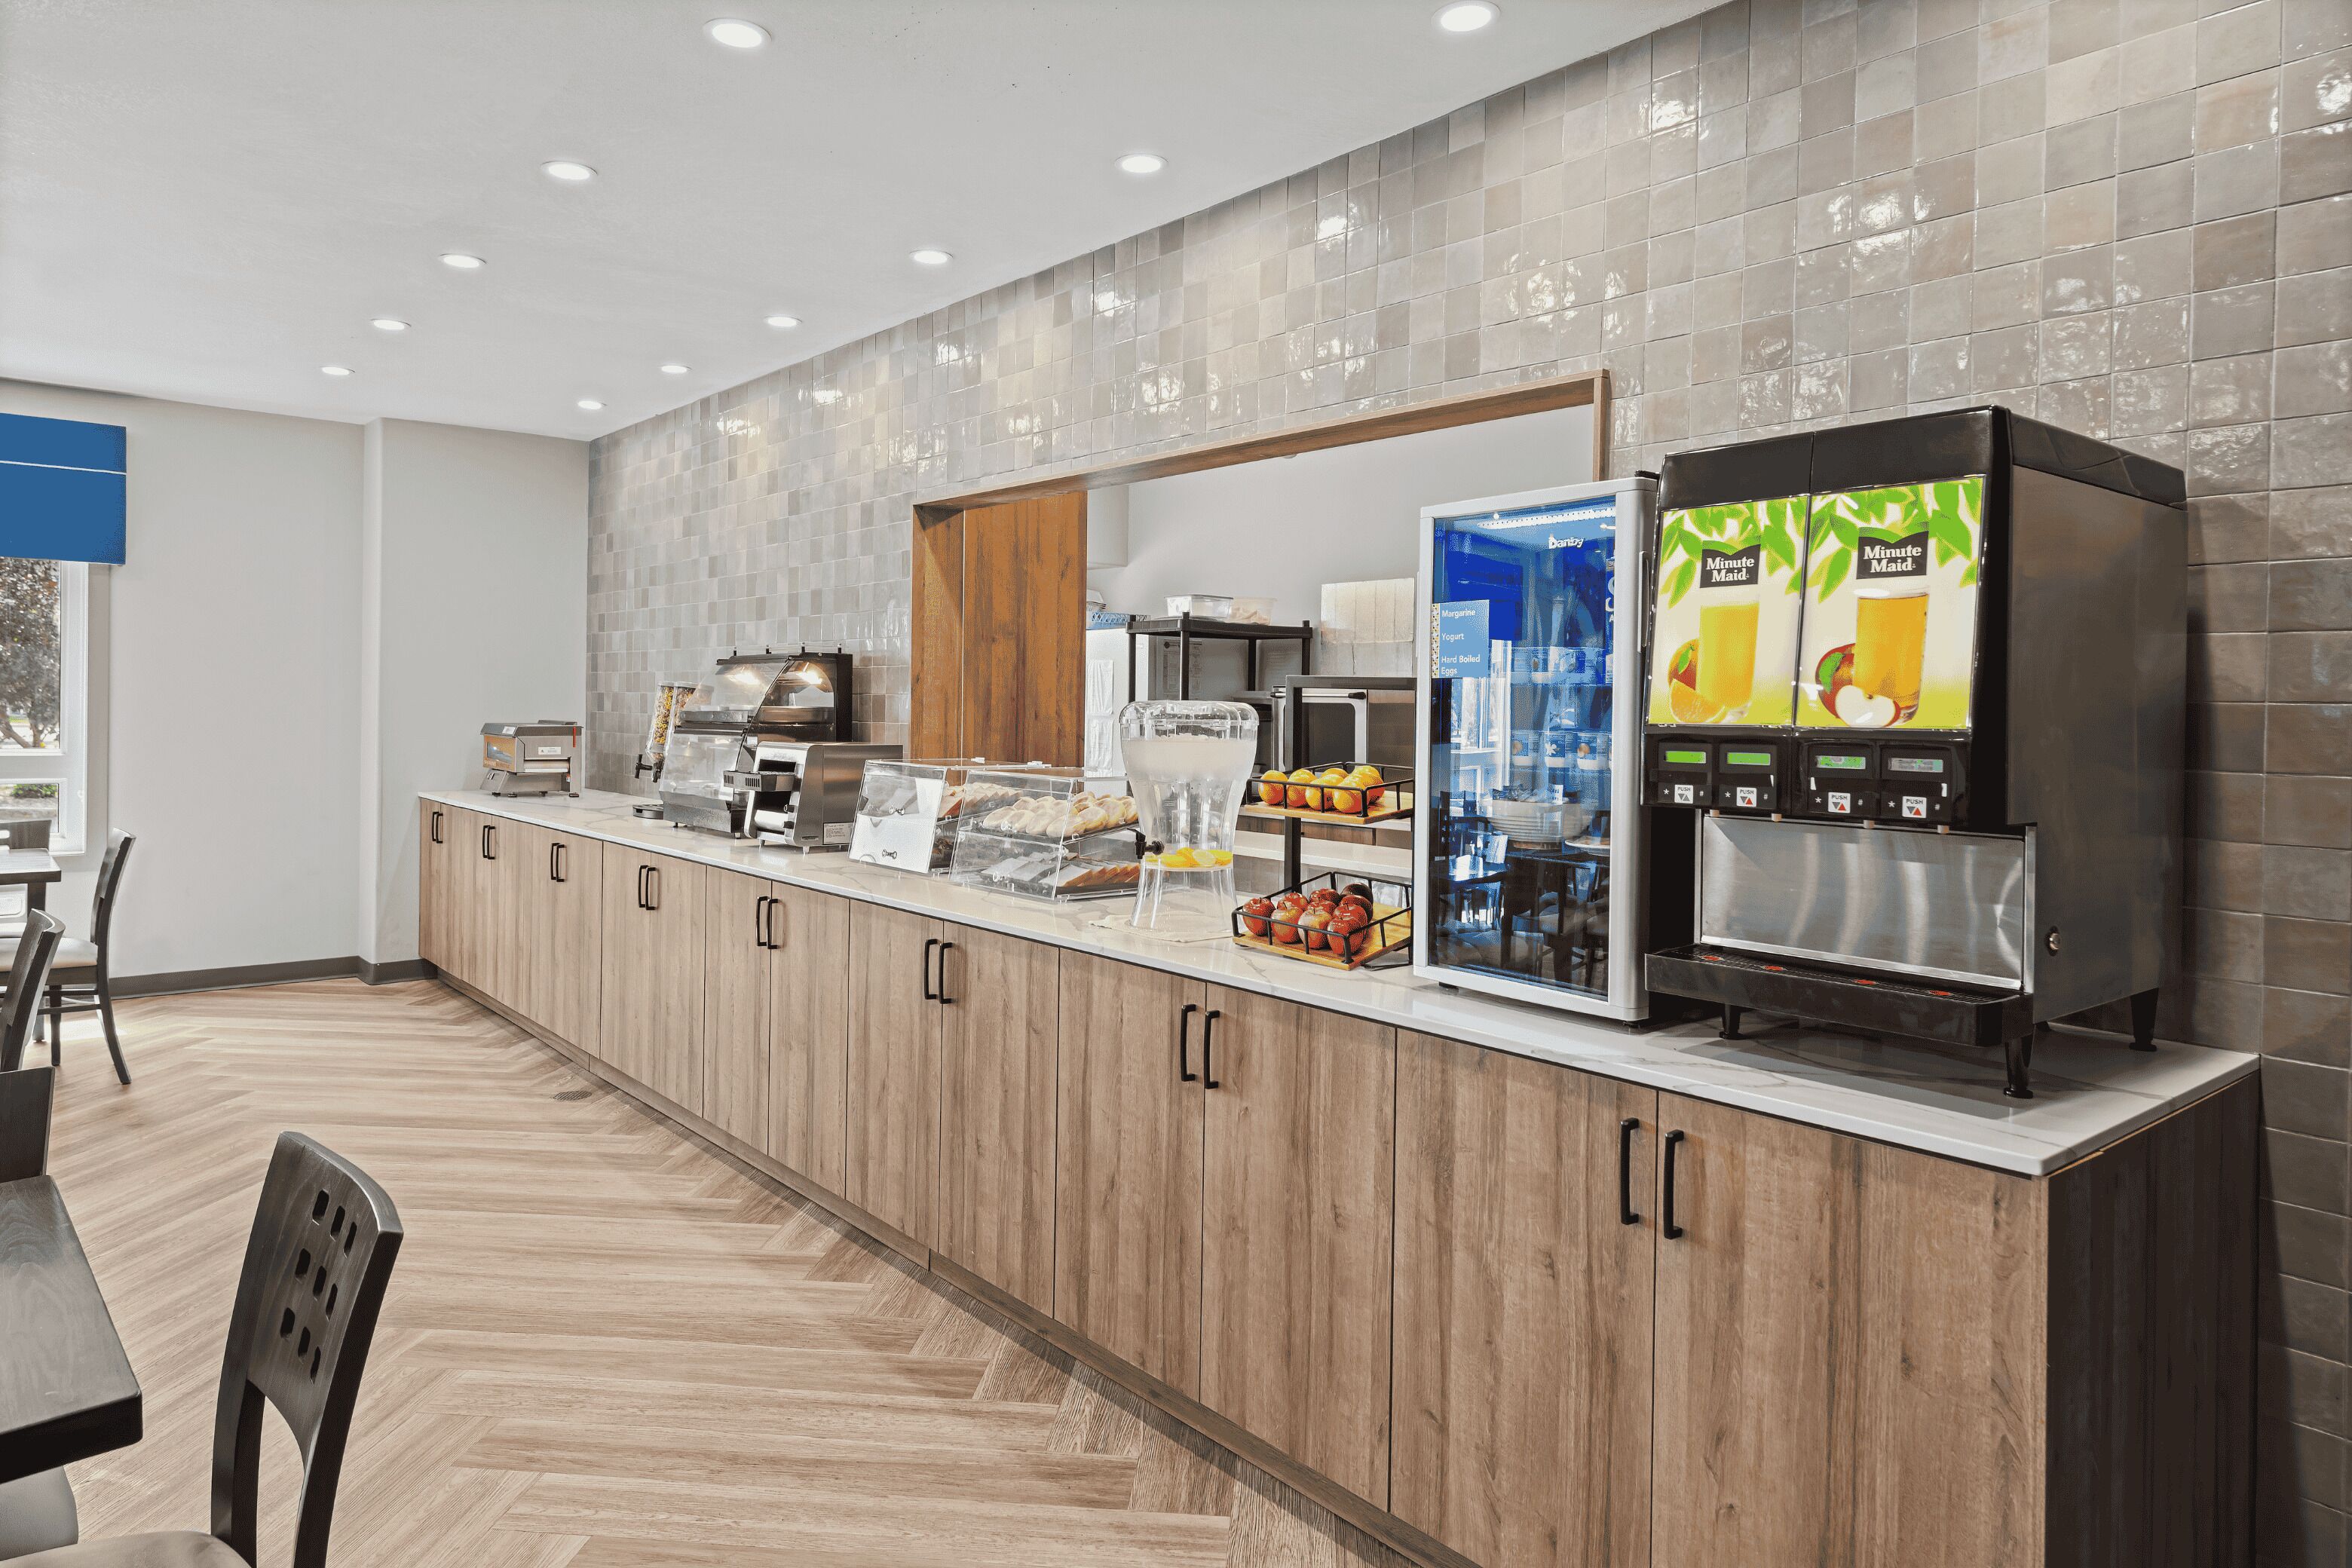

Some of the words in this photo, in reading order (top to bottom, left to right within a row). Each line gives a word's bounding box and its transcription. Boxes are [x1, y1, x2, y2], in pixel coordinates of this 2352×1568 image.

[1548, 537, 1584, 549] Danby
[1863, 544, 1922, 559] Minute
[1705, 556, 1755, 570] Minute
[1870, 557, 1913, 573] Maid
[1710, 568, 1747, 582] Maid
[1441, 609, 1476, 618] Margarine
[1441, 633, 1465, 642] Yogurt
[1441, 655, 1457, 663] Hard
[1459, 654, 1481, 663] Boiled
[1441, 667, 1458, 676] Eggs
